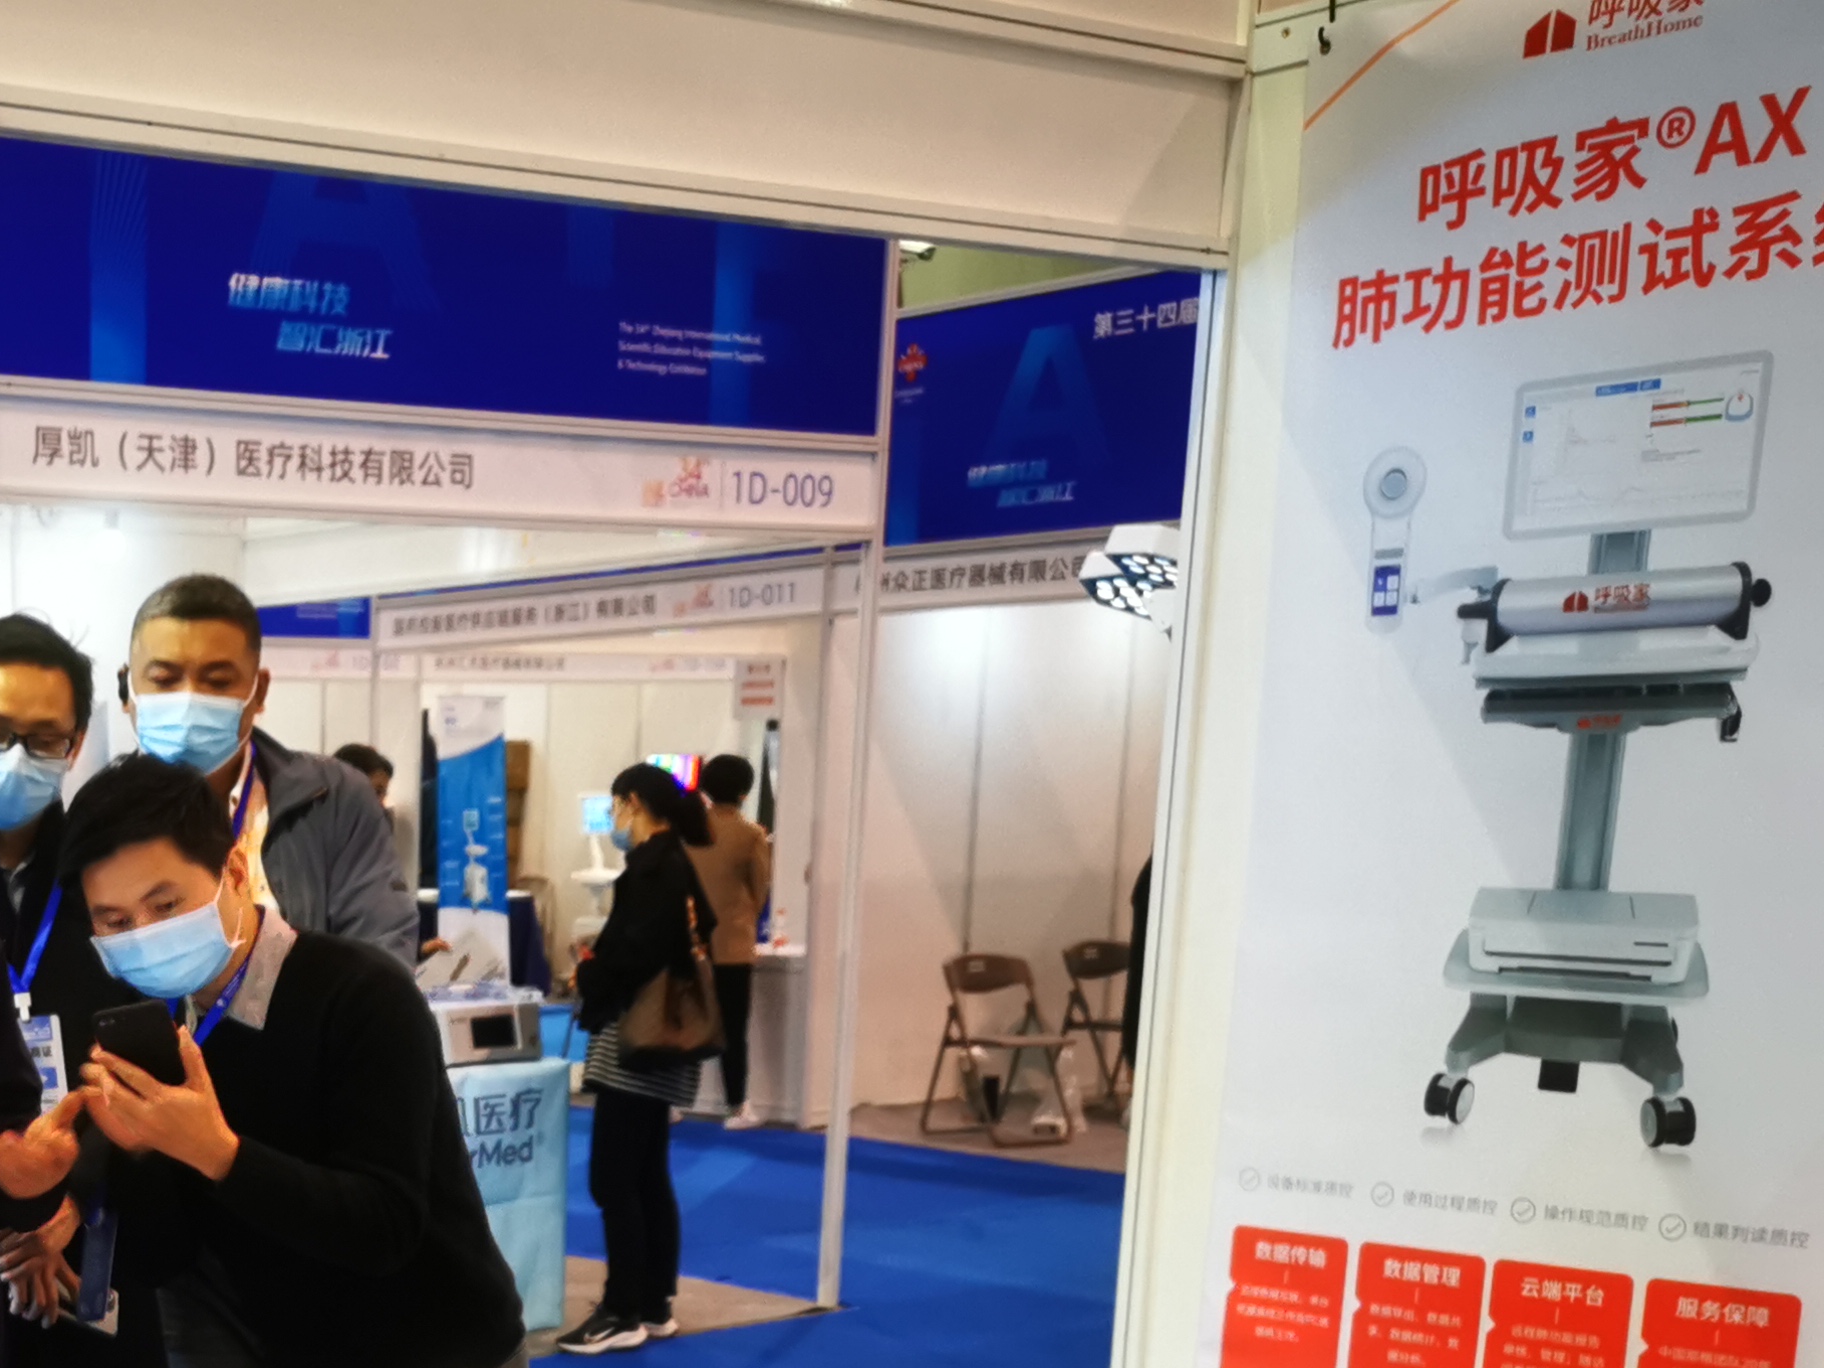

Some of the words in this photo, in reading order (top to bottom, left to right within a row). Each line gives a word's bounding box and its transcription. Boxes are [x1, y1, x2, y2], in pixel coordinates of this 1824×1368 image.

[1586, 14, 1703, 51] BreathHome
[733, 470, 835, 507] 1D-009
[729, 582, 796, 609] 1D-011
[1255, 1241, 1327, 1269] 数据传输
[1383, 1257, 1461, 1288] 数据管理
[1521, 1276, 1604, 1307] 云端平台
[1675, 1296, 1770, 1329] 服务保障
